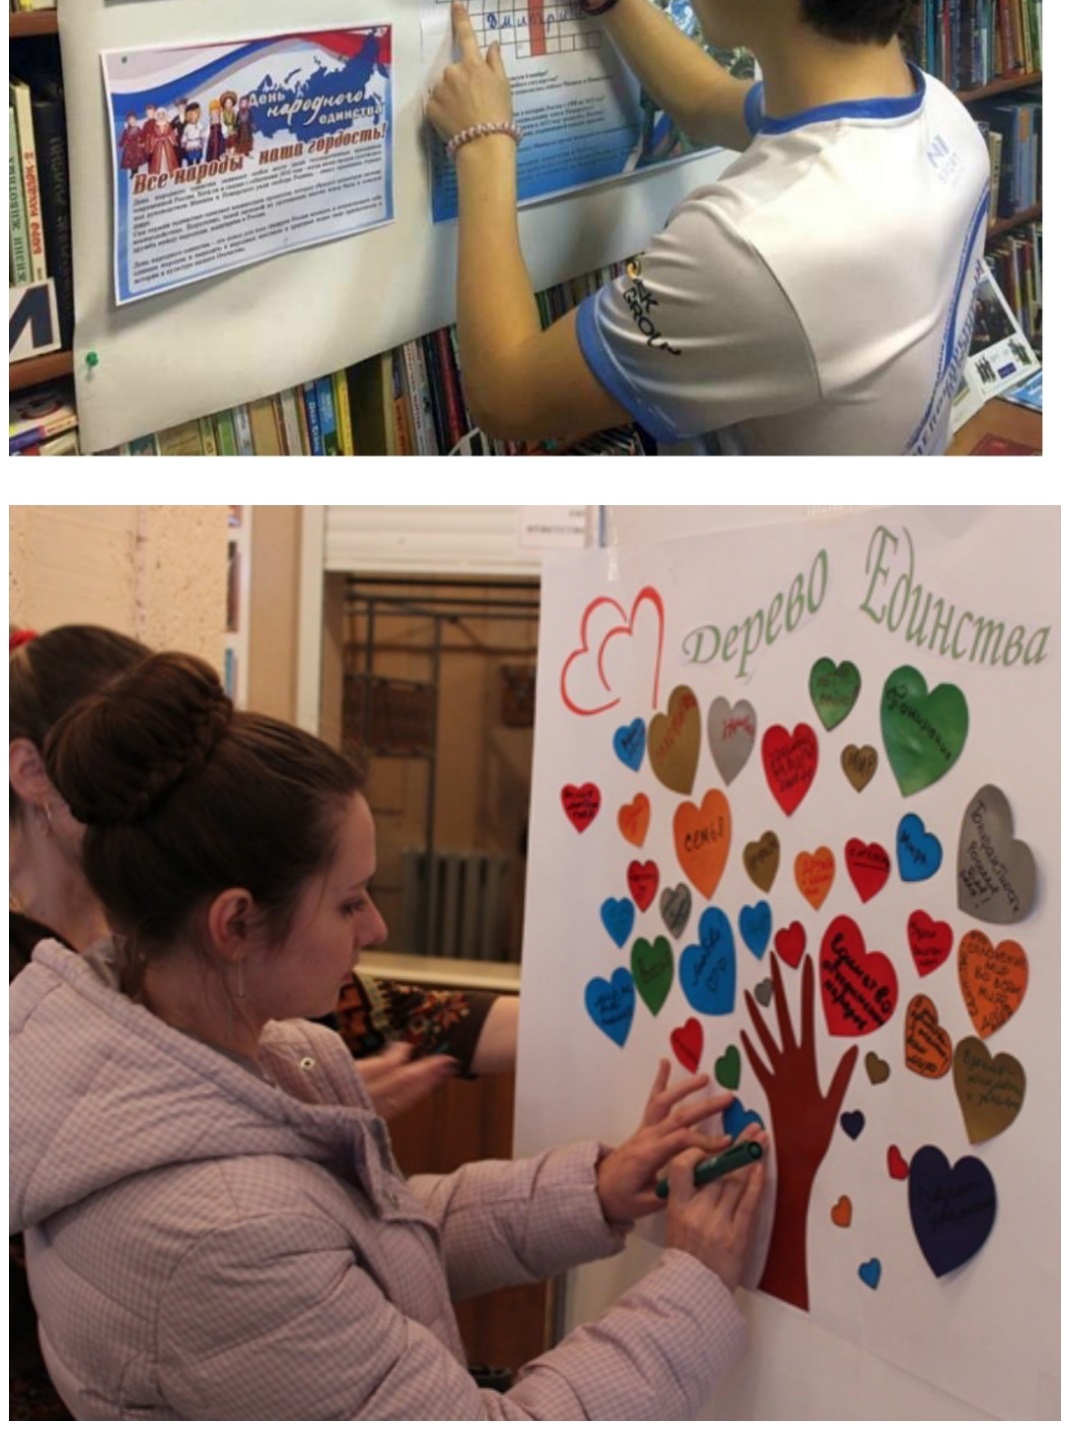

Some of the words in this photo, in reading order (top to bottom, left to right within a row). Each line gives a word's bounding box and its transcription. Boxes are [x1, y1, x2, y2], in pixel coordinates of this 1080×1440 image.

[248, 90, 285, 107] День
[267, 90, 363, 126] народного
[319, 105, 384, 125] единства
[132, 170, 169, 195] Все
[174, 153, 245, 190] народы
[259, 142, 304, 166] наша
[307, 122, 389, 157] гордость!
[681, 548, 829, 680] Дерево
[859, 525, 1053, 667] Единства
